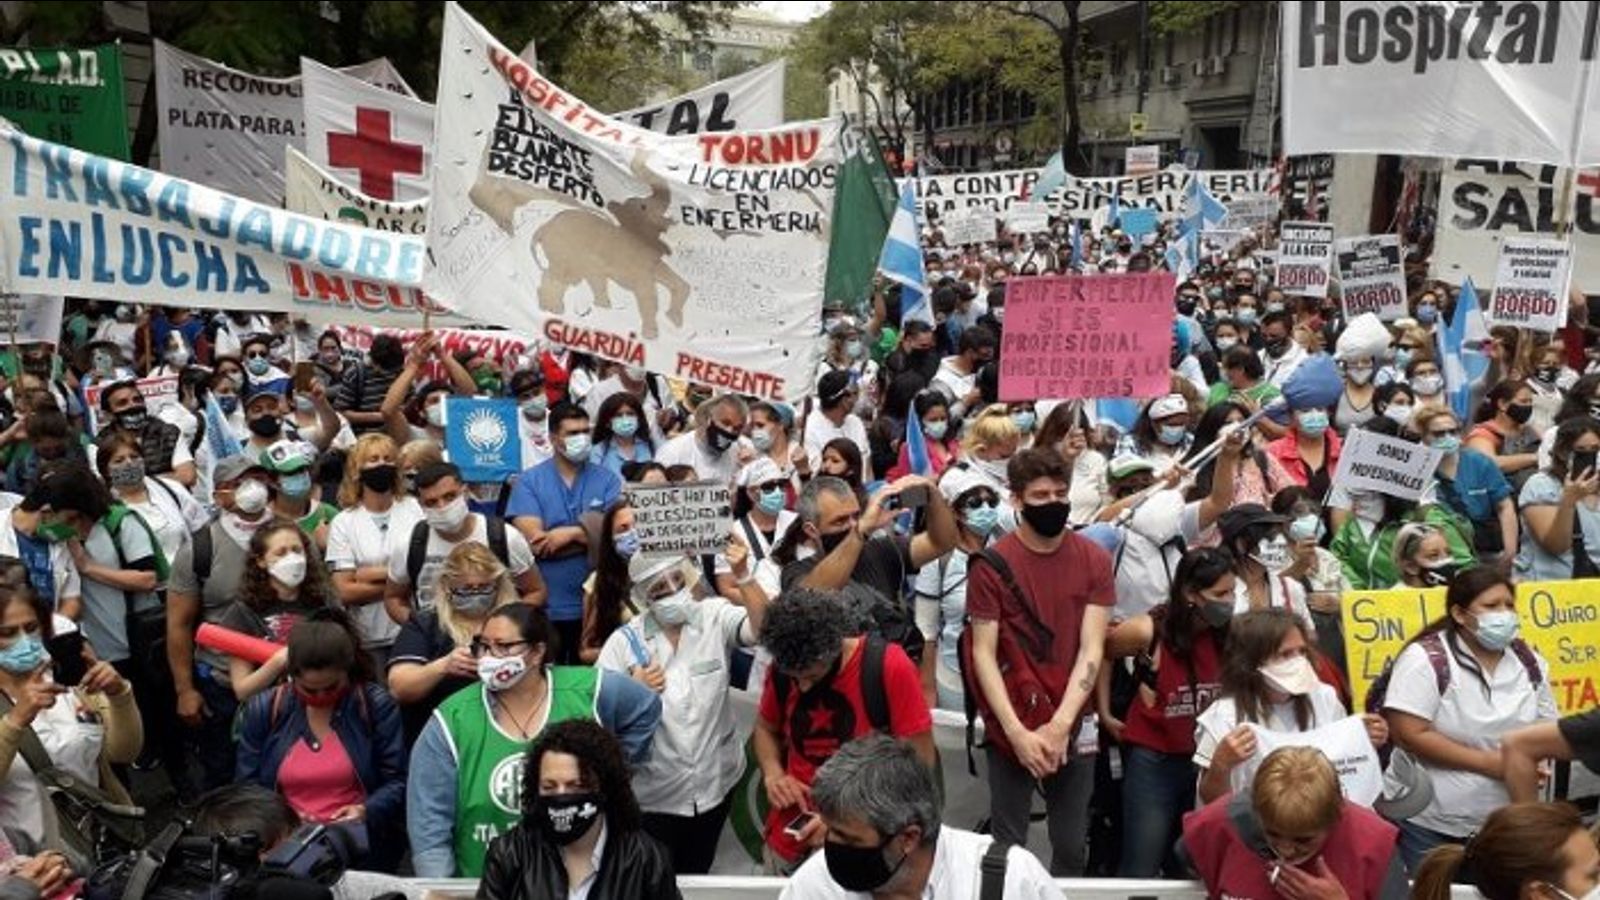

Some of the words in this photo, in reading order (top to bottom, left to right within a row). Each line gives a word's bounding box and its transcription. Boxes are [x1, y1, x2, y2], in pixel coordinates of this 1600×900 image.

[1299, 0, 1560, 75] Hospital
[168, 108, 234, 133] PLATA
[239, 116, 295, 137] PARA
[700, 128, 820, 165] TORNU
[688, 163, 836, 193] LICENCIADOS
[736, 194, 770, 213] EN
[676, 353, 786, 401] PRESENTE
